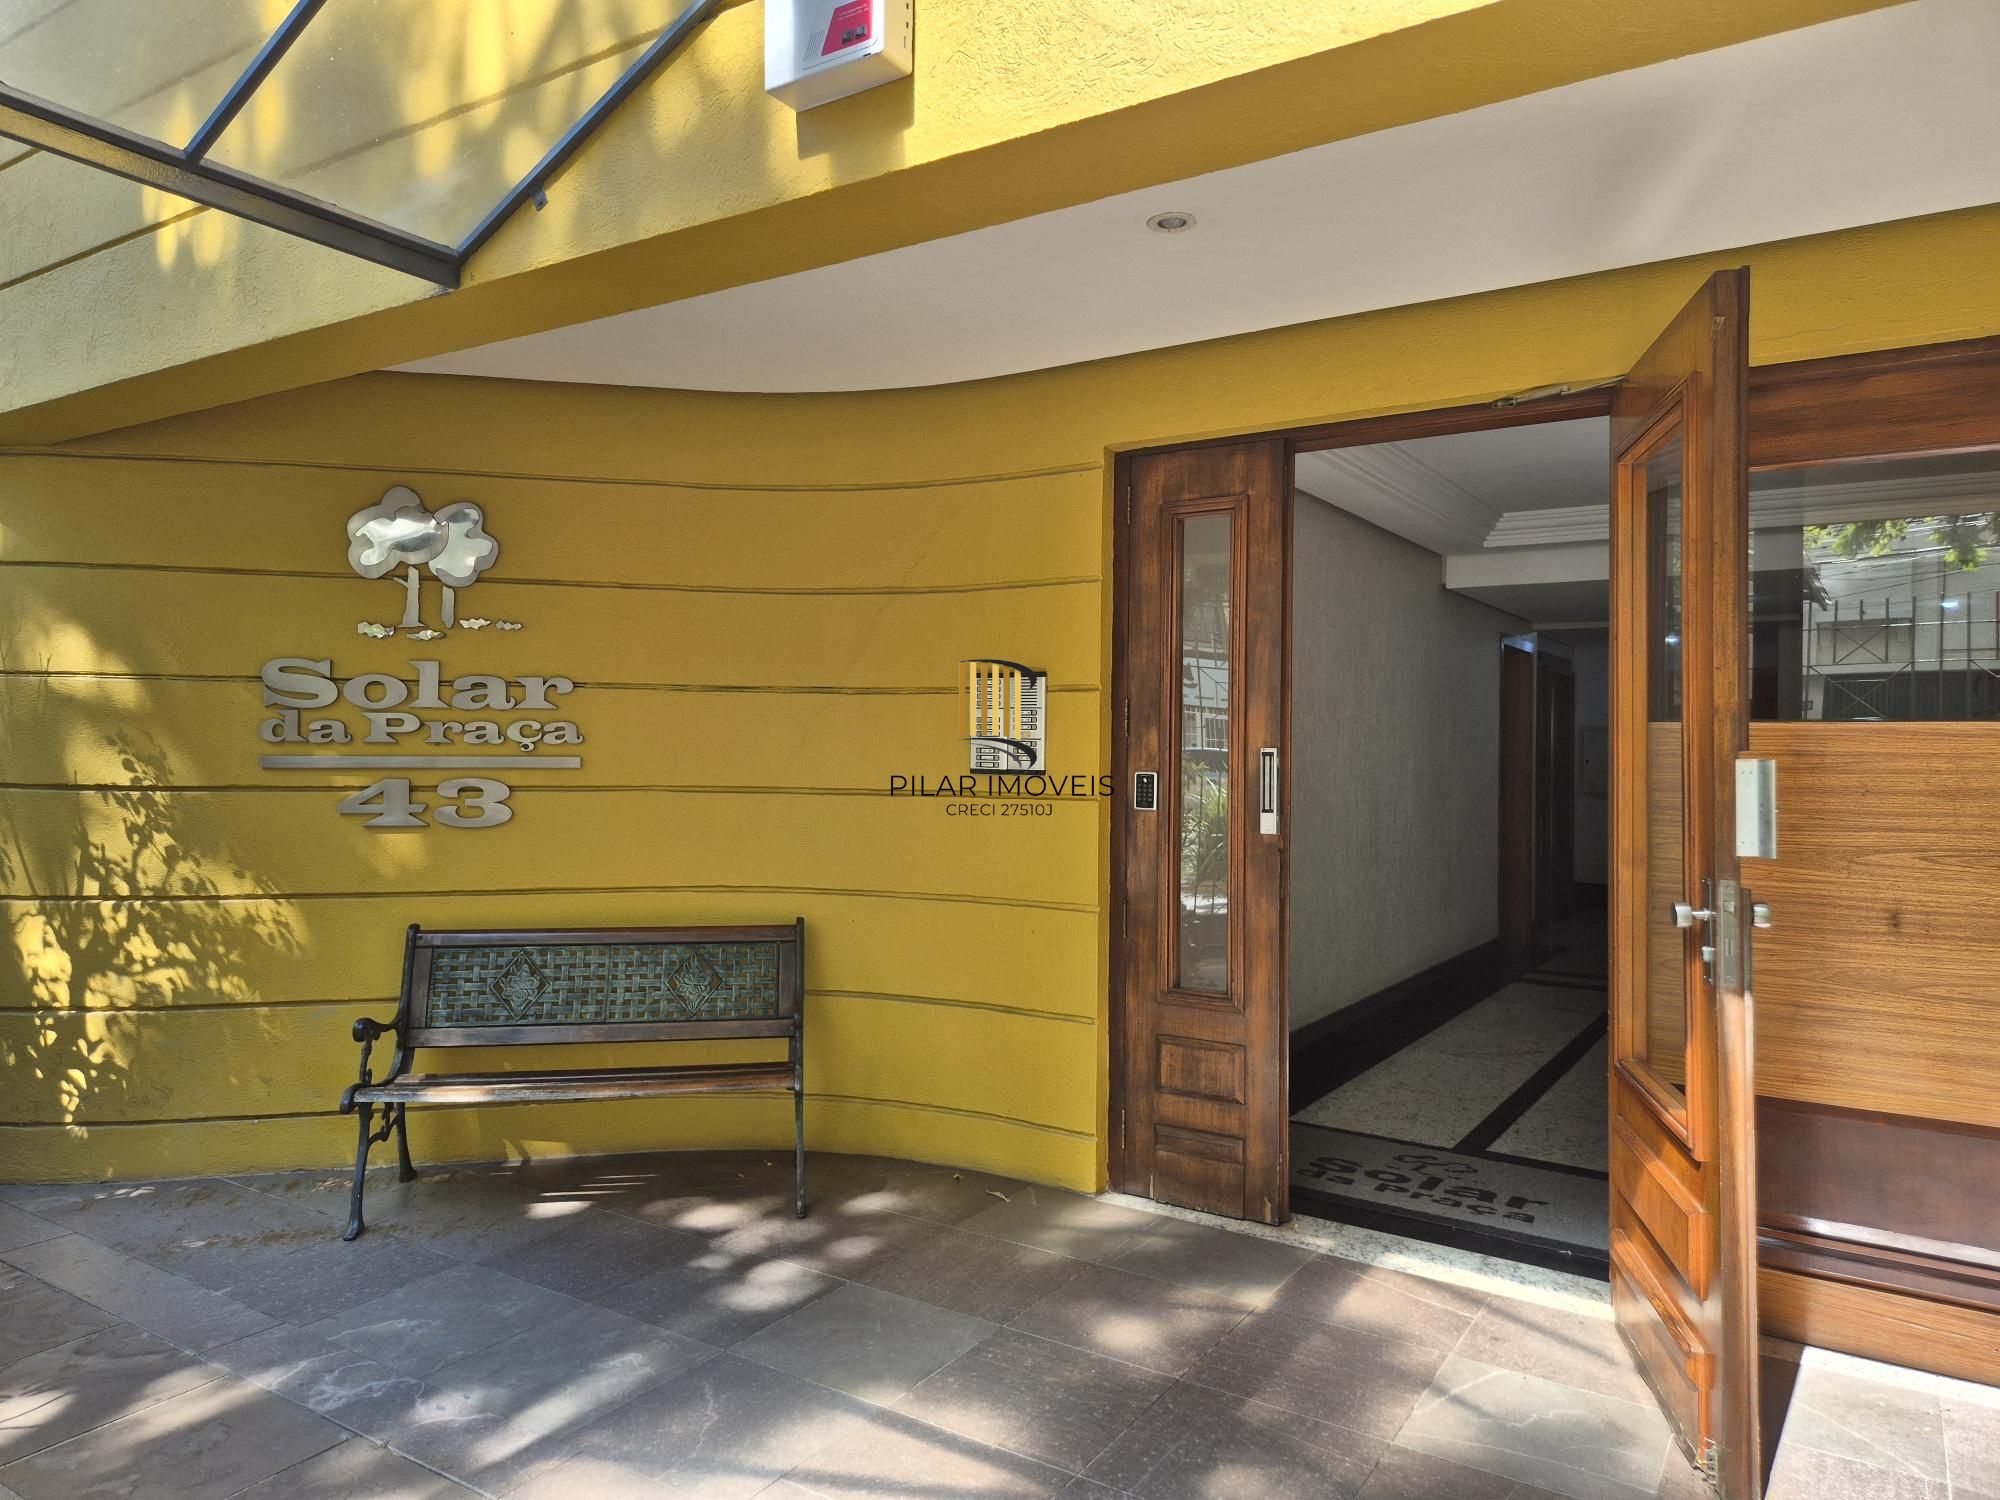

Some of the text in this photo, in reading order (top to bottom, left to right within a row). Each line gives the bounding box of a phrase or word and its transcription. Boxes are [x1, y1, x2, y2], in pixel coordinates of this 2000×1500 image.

[261, 658, 575, 710] Solar
[260, 709, 585, 752] da Praça
[336, 778, 513, 828] 43
[1309, 1156, 1549, 1210] Solar
